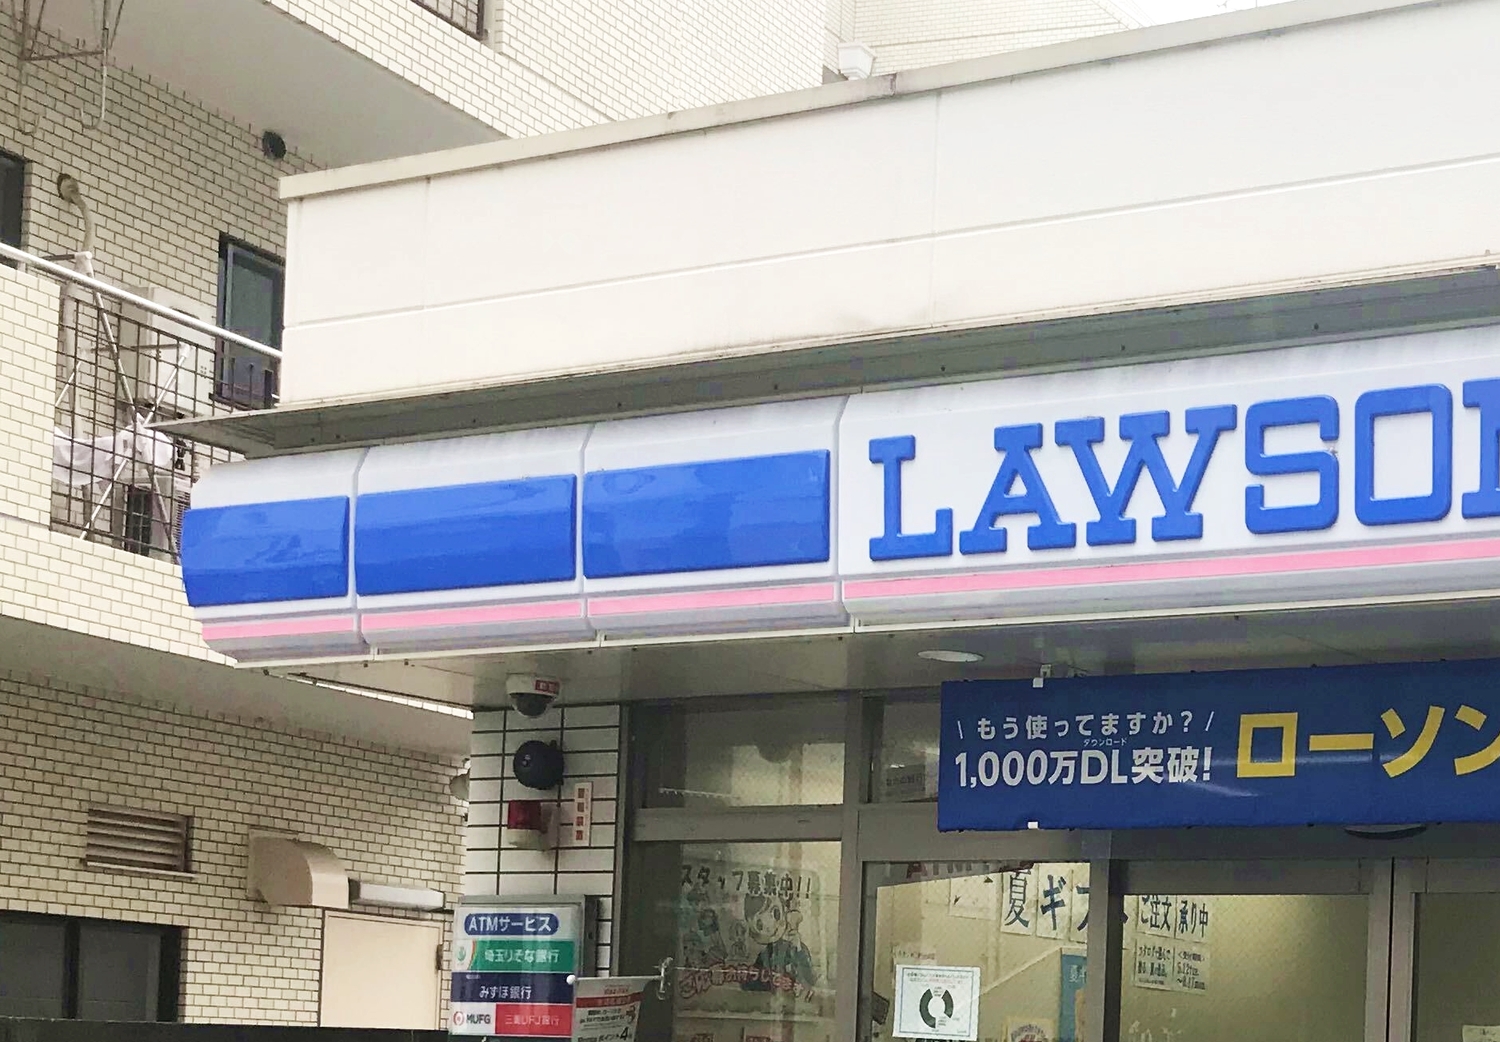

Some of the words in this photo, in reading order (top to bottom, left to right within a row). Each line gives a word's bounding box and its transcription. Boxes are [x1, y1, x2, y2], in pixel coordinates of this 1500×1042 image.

[955, 746, 1213, 789] 1,000万DL突破!
[468, 916, 552, 932] ATMサービス
[484, 949, 560, 963] 埼玉りそな銀行
[479, 985, 532, 1000] みずほ銀行
[466, 1014, 492, 1025] MUFG
